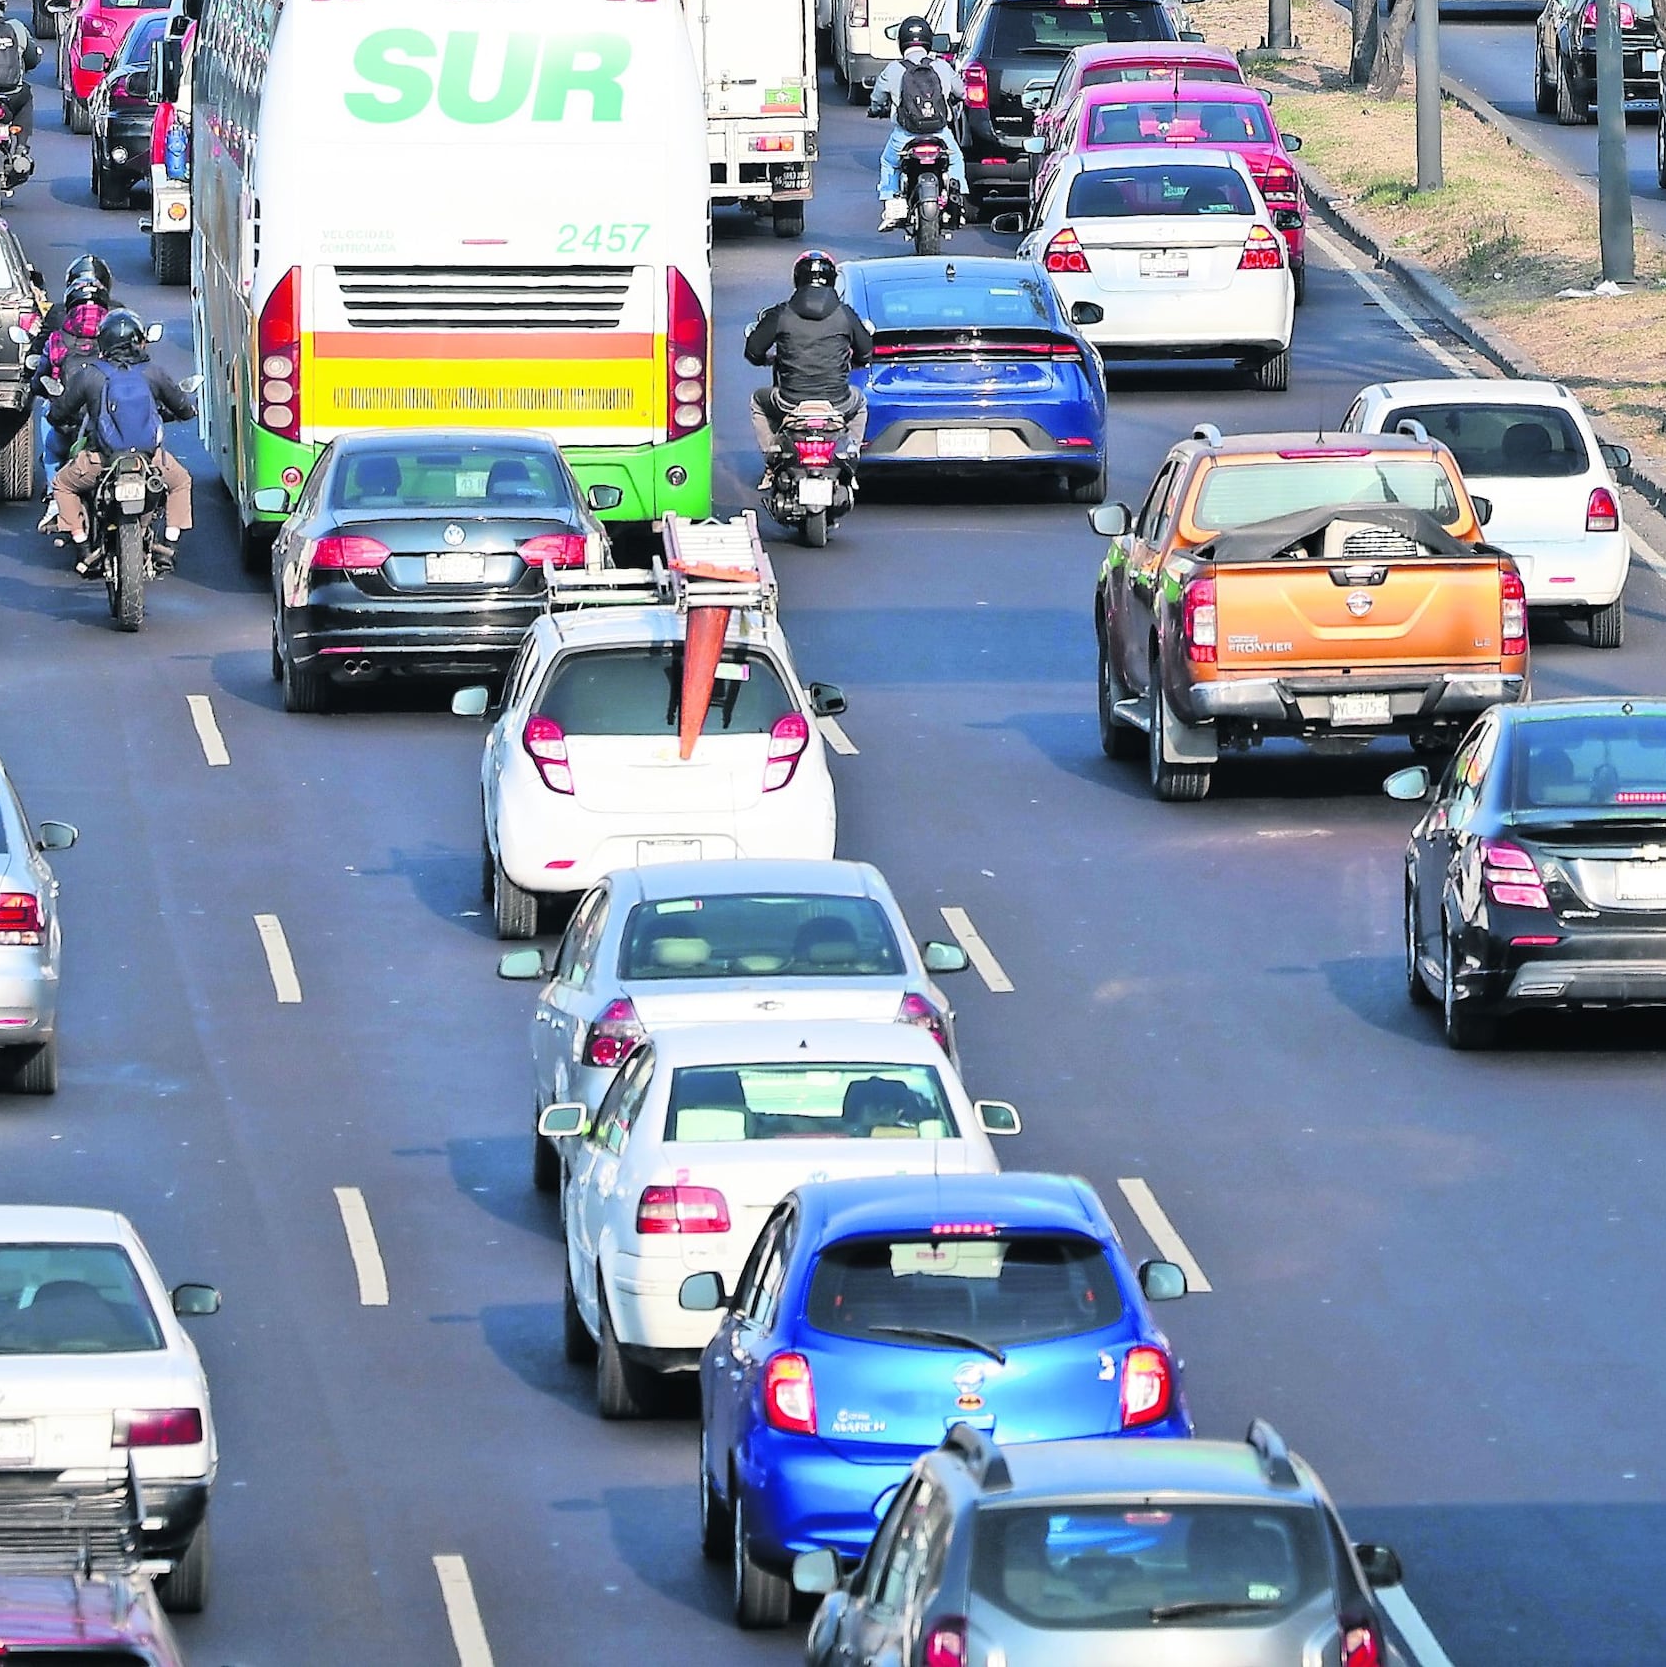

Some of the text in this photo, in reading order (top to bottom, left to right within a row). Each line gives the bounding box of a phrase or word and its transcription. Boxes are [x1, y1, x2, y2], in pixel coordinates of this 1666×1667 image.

[343, 27, 633, 125] SUR
[321, 229, 395, 241] VELOCIDAD
[555, 223, 652, 254] 2457
[319, 242, 397, 254] CONTROLADA
[1227, 641, 1294, 654] FRONTIER
